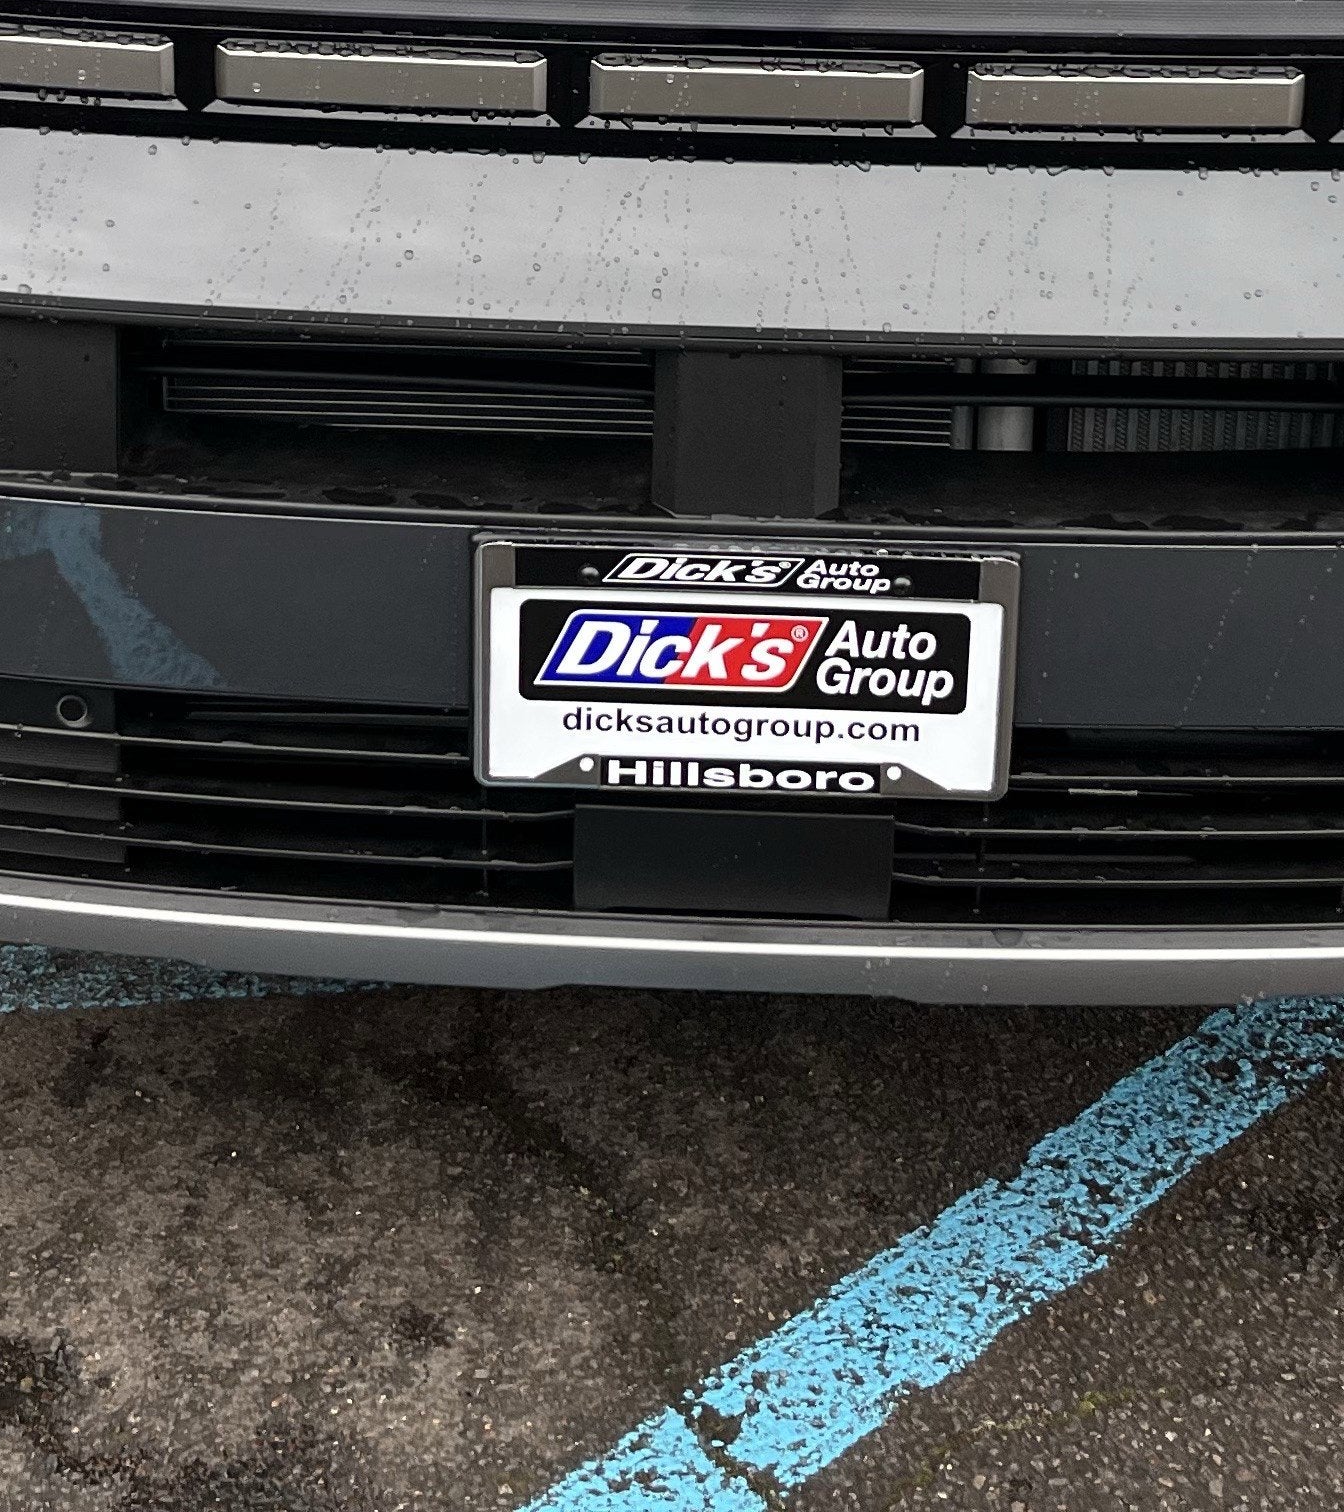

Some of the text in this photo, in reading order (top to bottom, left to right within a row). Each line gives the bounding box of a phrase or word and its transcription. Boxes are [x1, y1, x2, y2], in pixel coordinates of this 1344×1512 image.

[617, 557, 879, 584] Dick's Auto
[796, 574, 891, 595] Group
[555, 617, 937, 682] Dick's Auto
[815, 656, 955, 707] Group
[562, 707, 921, 745] dicksautogroup.com
[607, 758, 875, 792] Hillsboro
